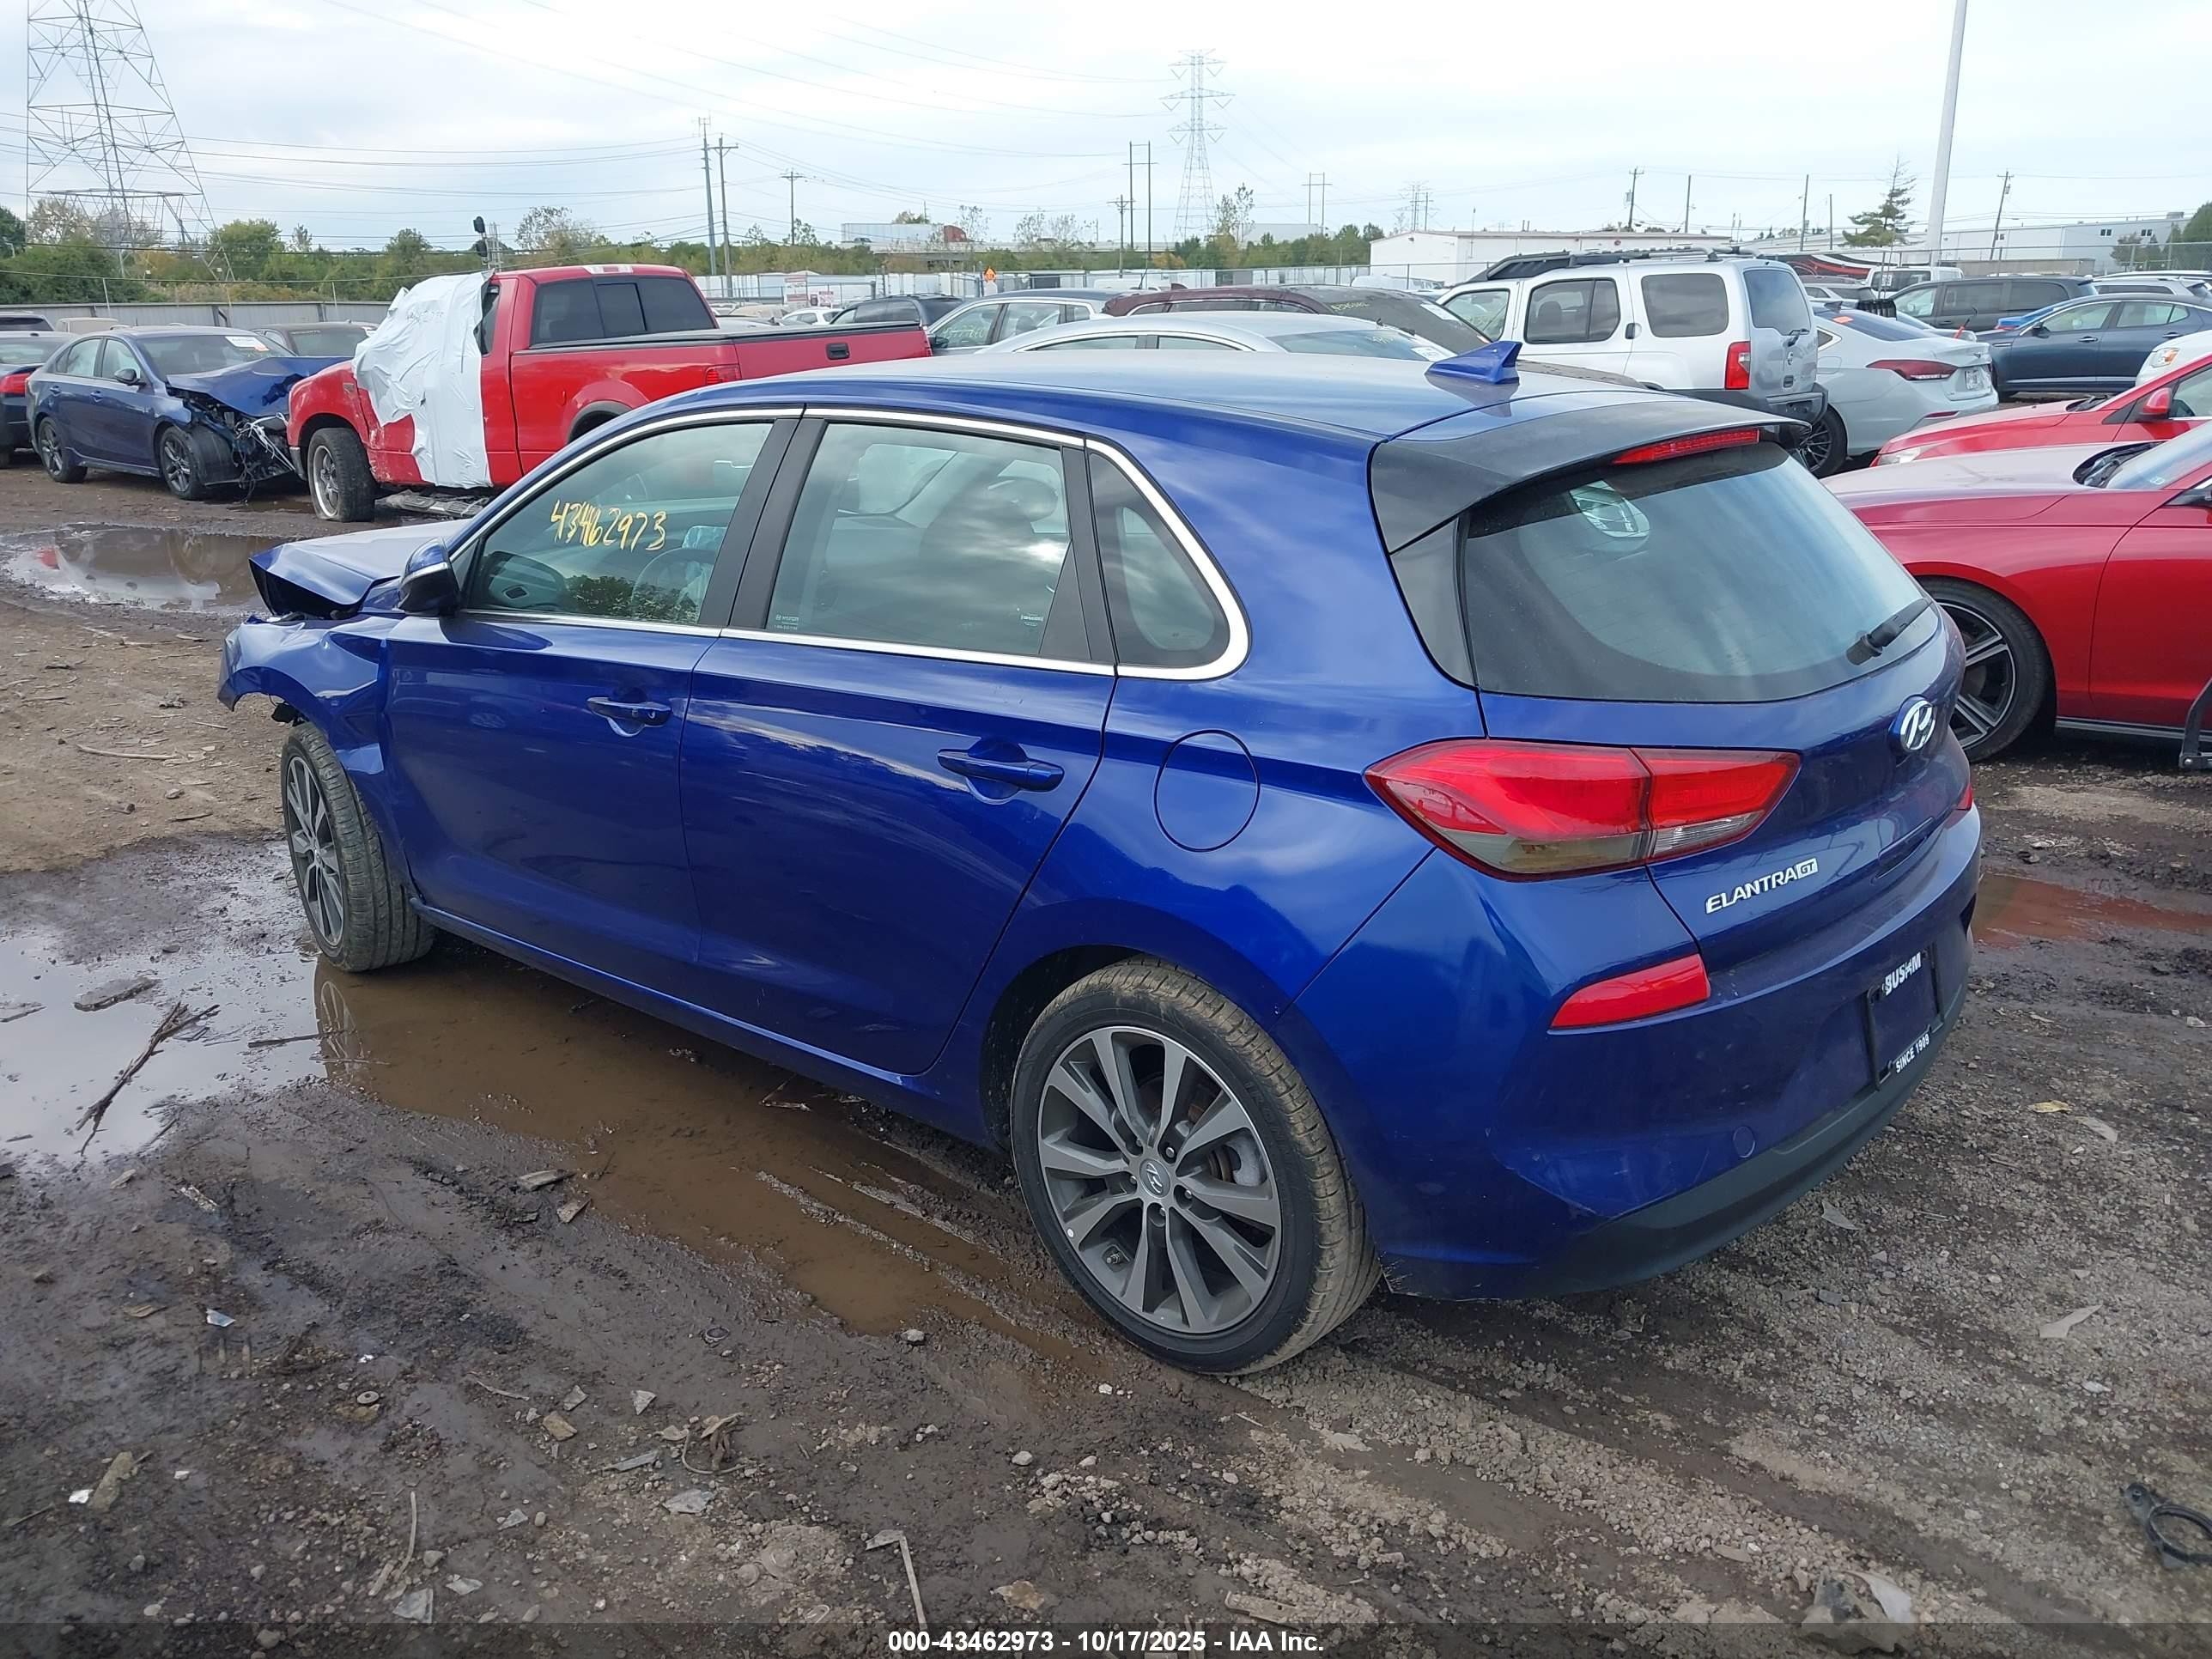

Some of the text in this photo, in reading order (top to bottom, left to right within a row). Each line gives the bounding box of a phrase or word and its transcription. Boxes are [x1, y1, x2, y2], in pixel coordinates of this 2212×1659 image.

[551, 500, 667, 552] 43462973
[1706, 866, 1798, 914] ELANTRA
[1895, 1046, 1916, 1073] SINCE
